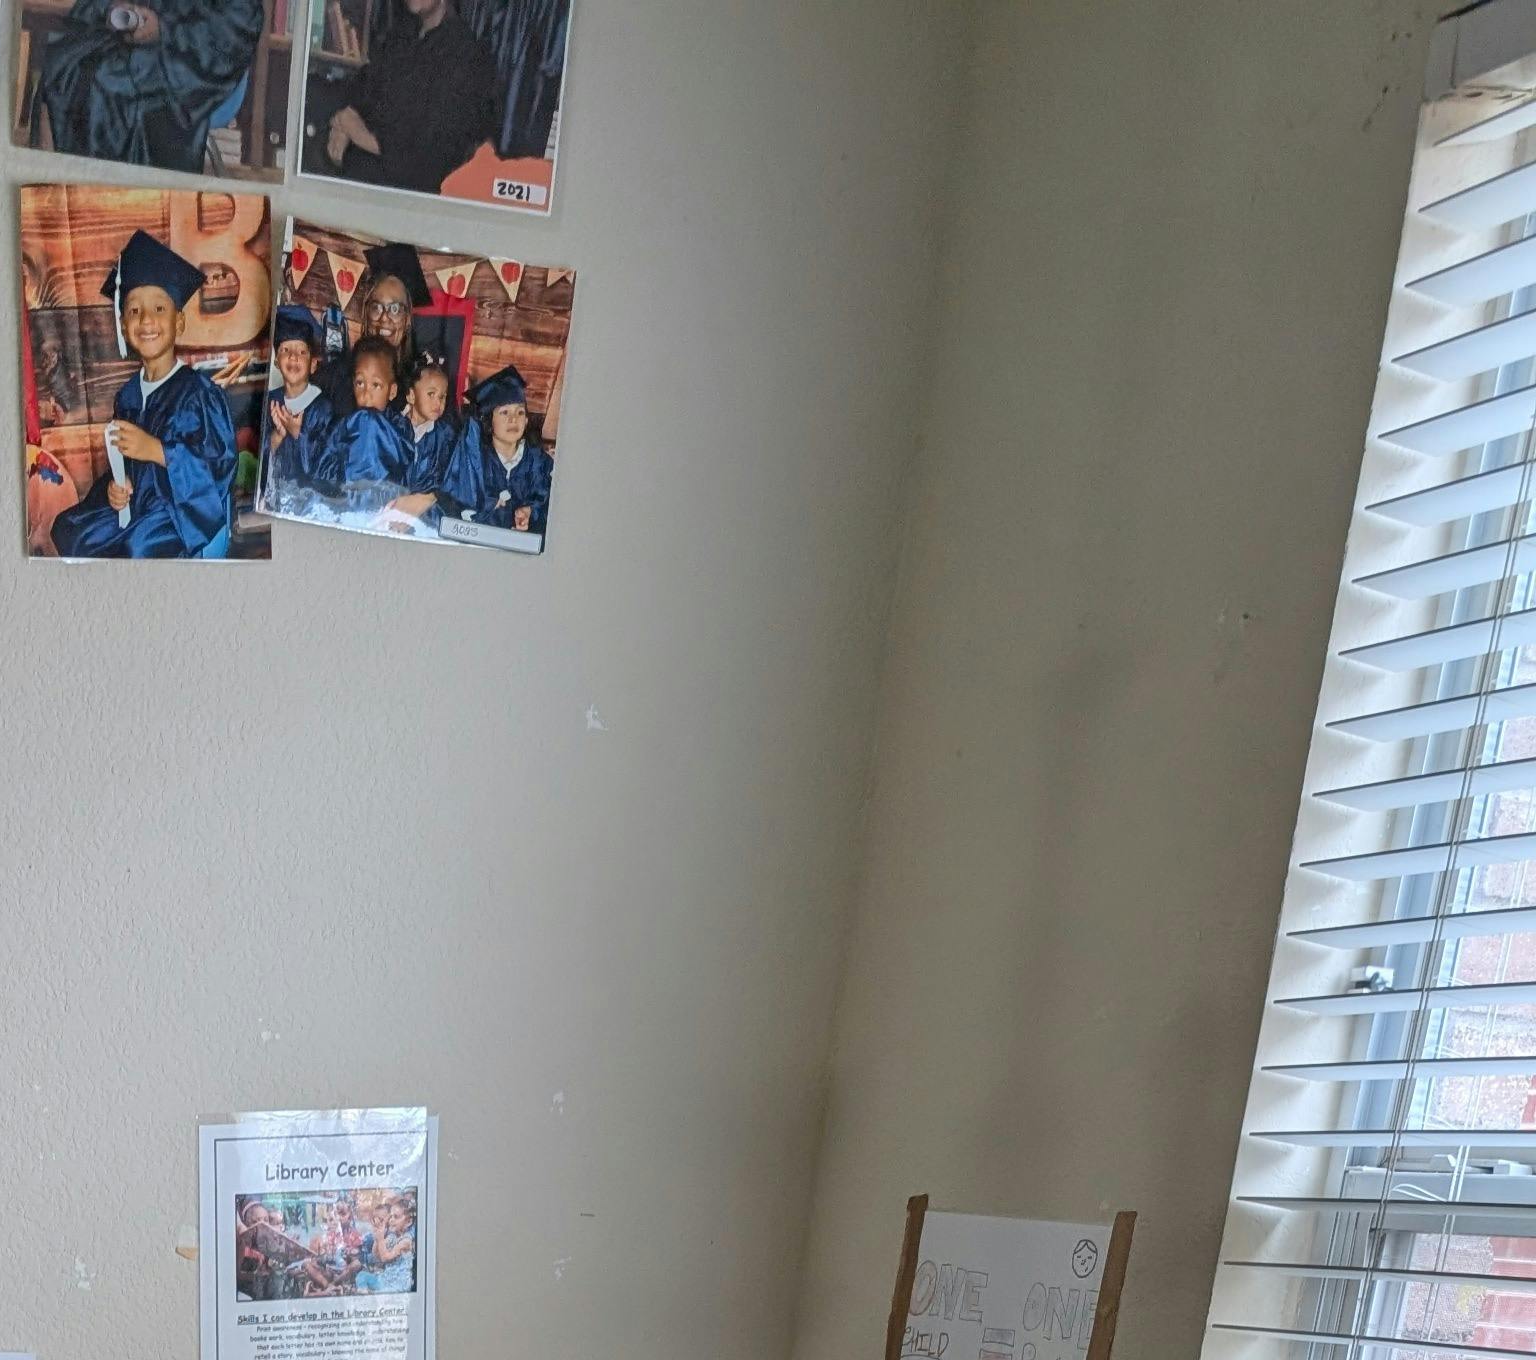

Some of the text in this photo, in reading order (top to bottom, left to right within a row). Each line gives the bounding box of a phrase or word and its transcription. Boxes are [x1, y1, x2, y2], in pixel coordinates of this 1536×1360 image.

[495, 180, 533, 202] 2021
[266, 1162, 395, 1182] Library Center
[908, 1260, 989, 1323] ONE
[238, 1314, 259, 1323] Skills
[262, 1314, 267, 1322] I
[289, 1312, 317, 1322] develop
